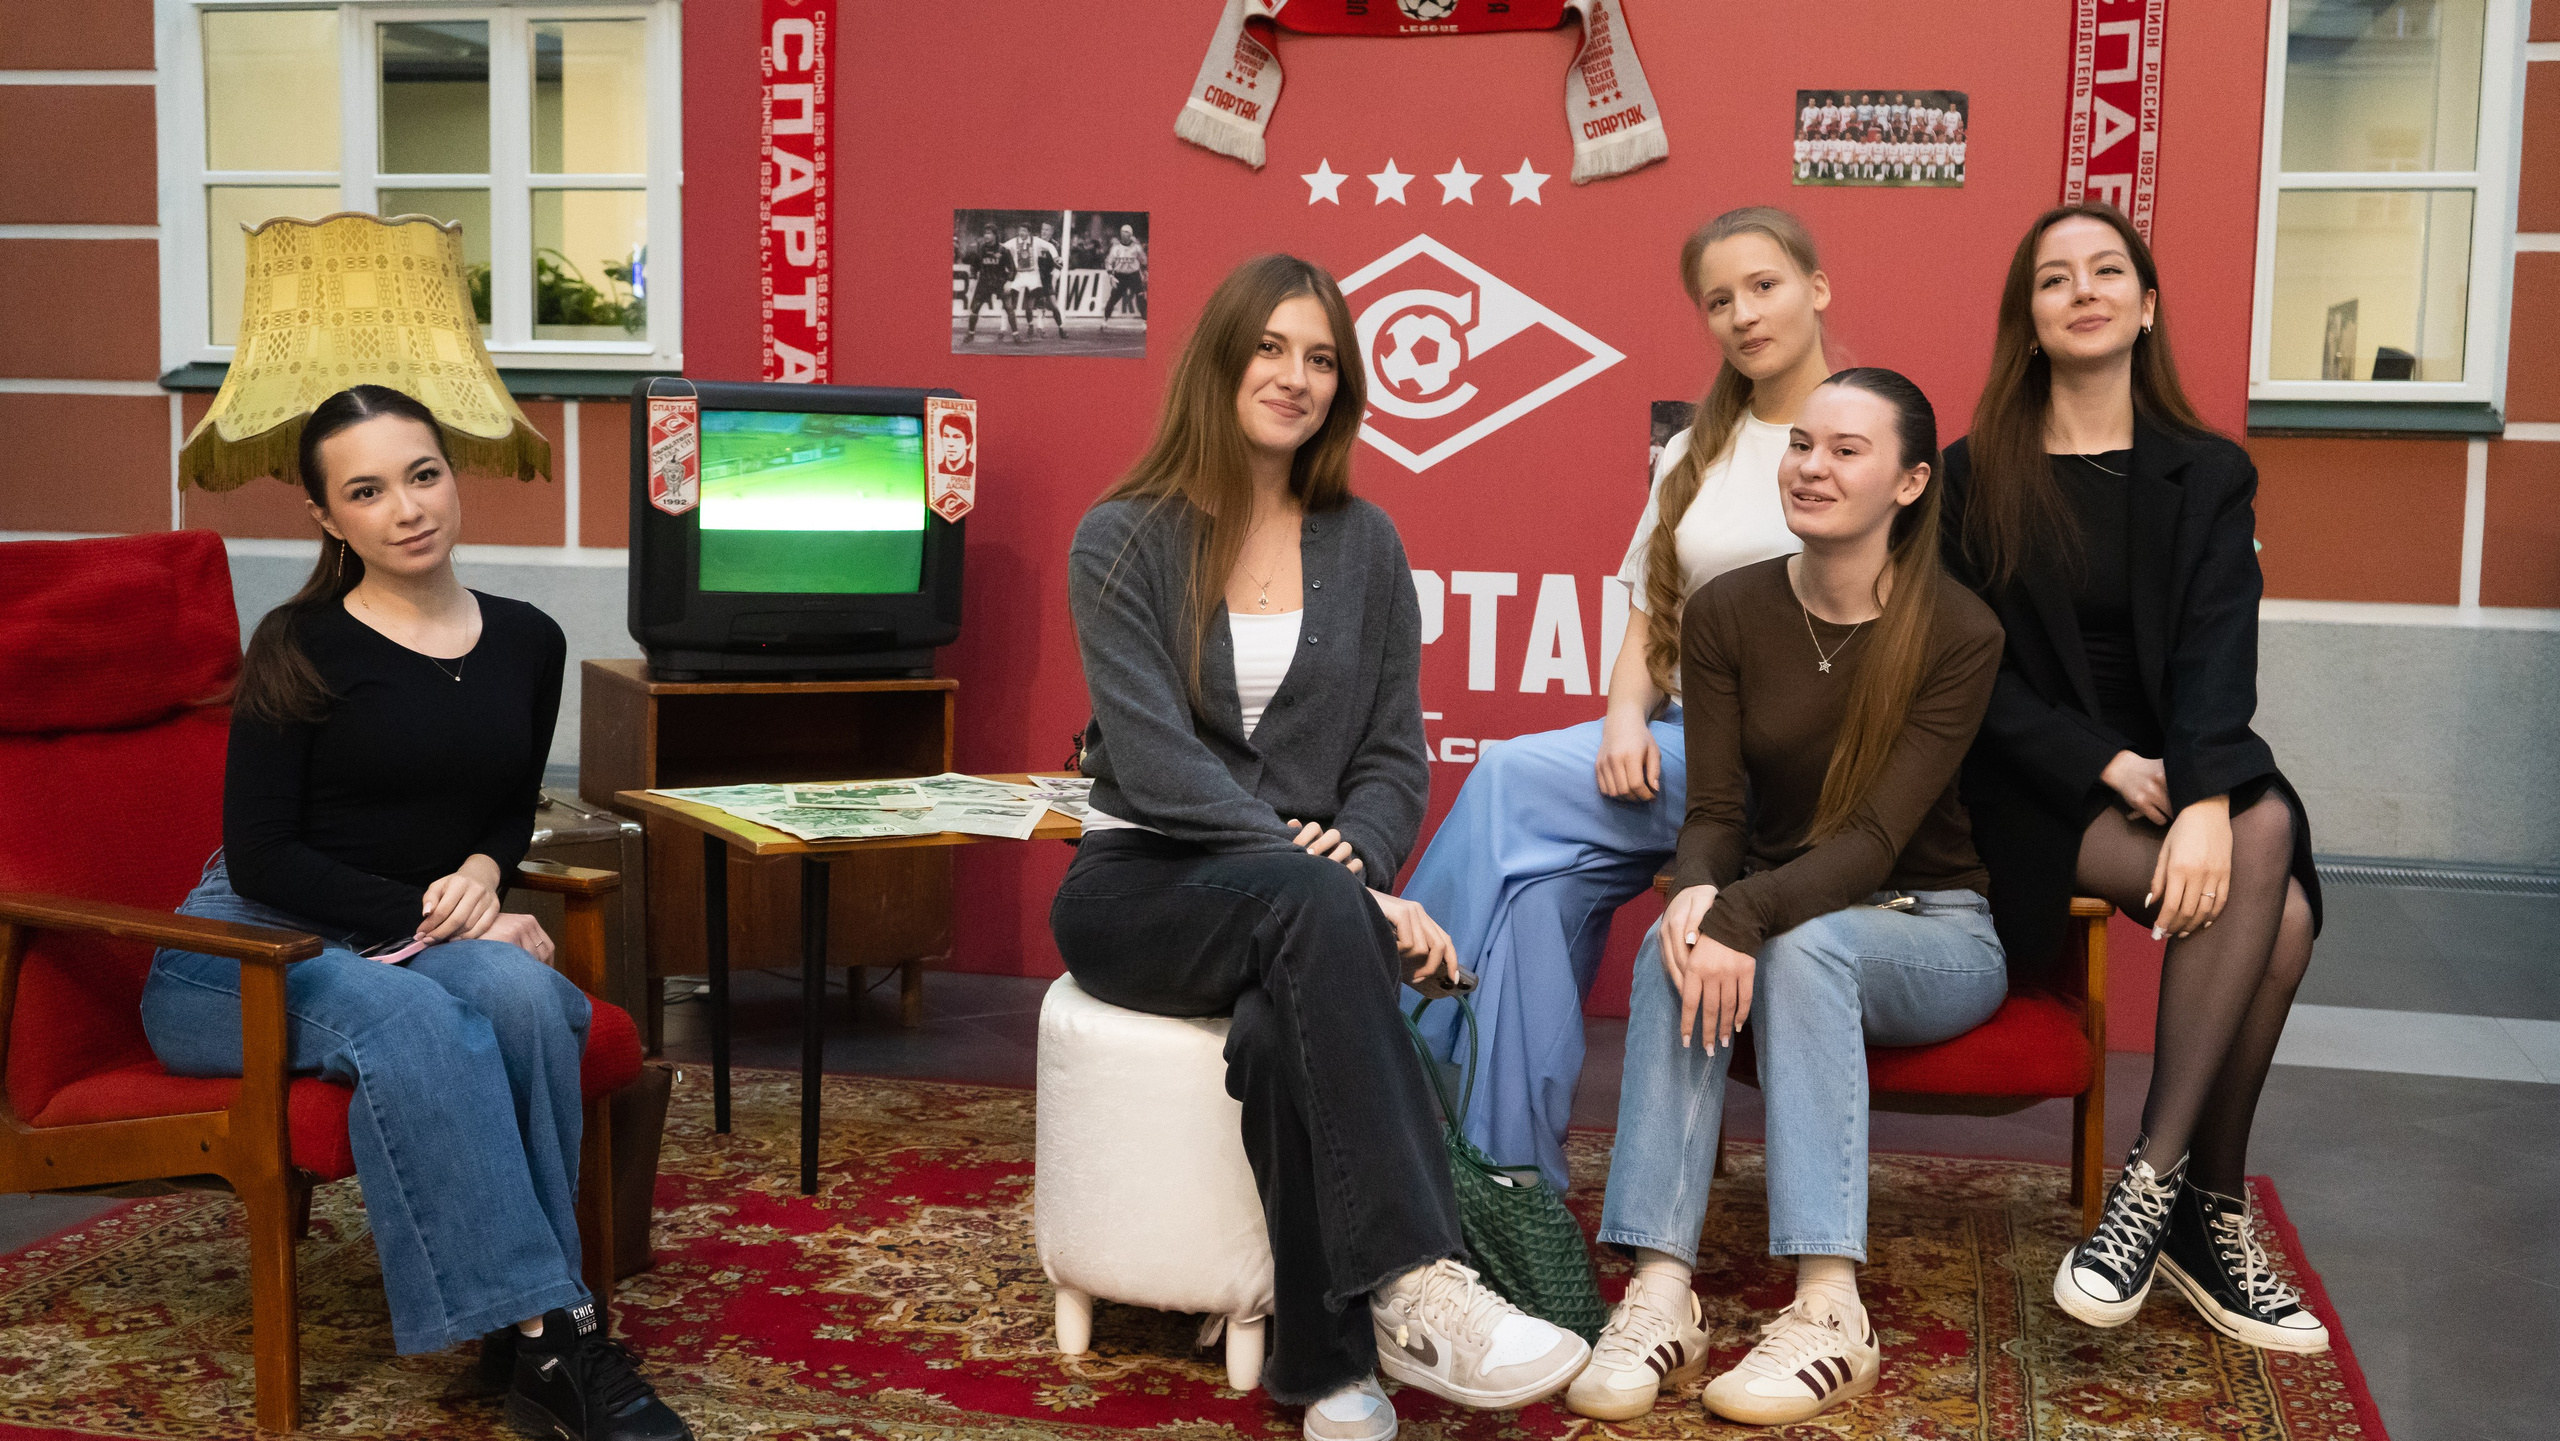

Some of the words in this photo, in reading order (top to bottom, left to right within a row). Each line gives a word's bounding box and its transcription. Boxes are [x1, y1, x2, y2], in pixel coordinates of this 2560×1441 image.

[1400, 25, 1459, 33] LEAGUE
[2146, 0, 2162, 48] ПИОН
[760, 46, 773, 77] CUP
[814, 10, 826, 104] CHAMPIONS
[1581, 58, 1613, 76] РОБСОН
[2076, 0, 2095, 98] БЛАДАТЕЛЬ
[1204, 84, 1261, 121] СПАРТАК
[2088, 0, 2141, 219] ПАР
[2142, 63, 2159, 132] РОССИИ
[760, 85, 773, 156] WINNERS
[1583, 103, 1647, 140] СПАРТАК
[2070, 112, 2087, 167] КУБКА
[771, 18, 817, 383] СПАРТА
[2067, 180, 2082, 208] РО
[651, 404, 695, 413] СПАРТАК
[941, 401, 975, 411] СПАРТАК
[573, 1303, 594, 1320] CHIC
[578, 1322, 598, 1337] 1980
